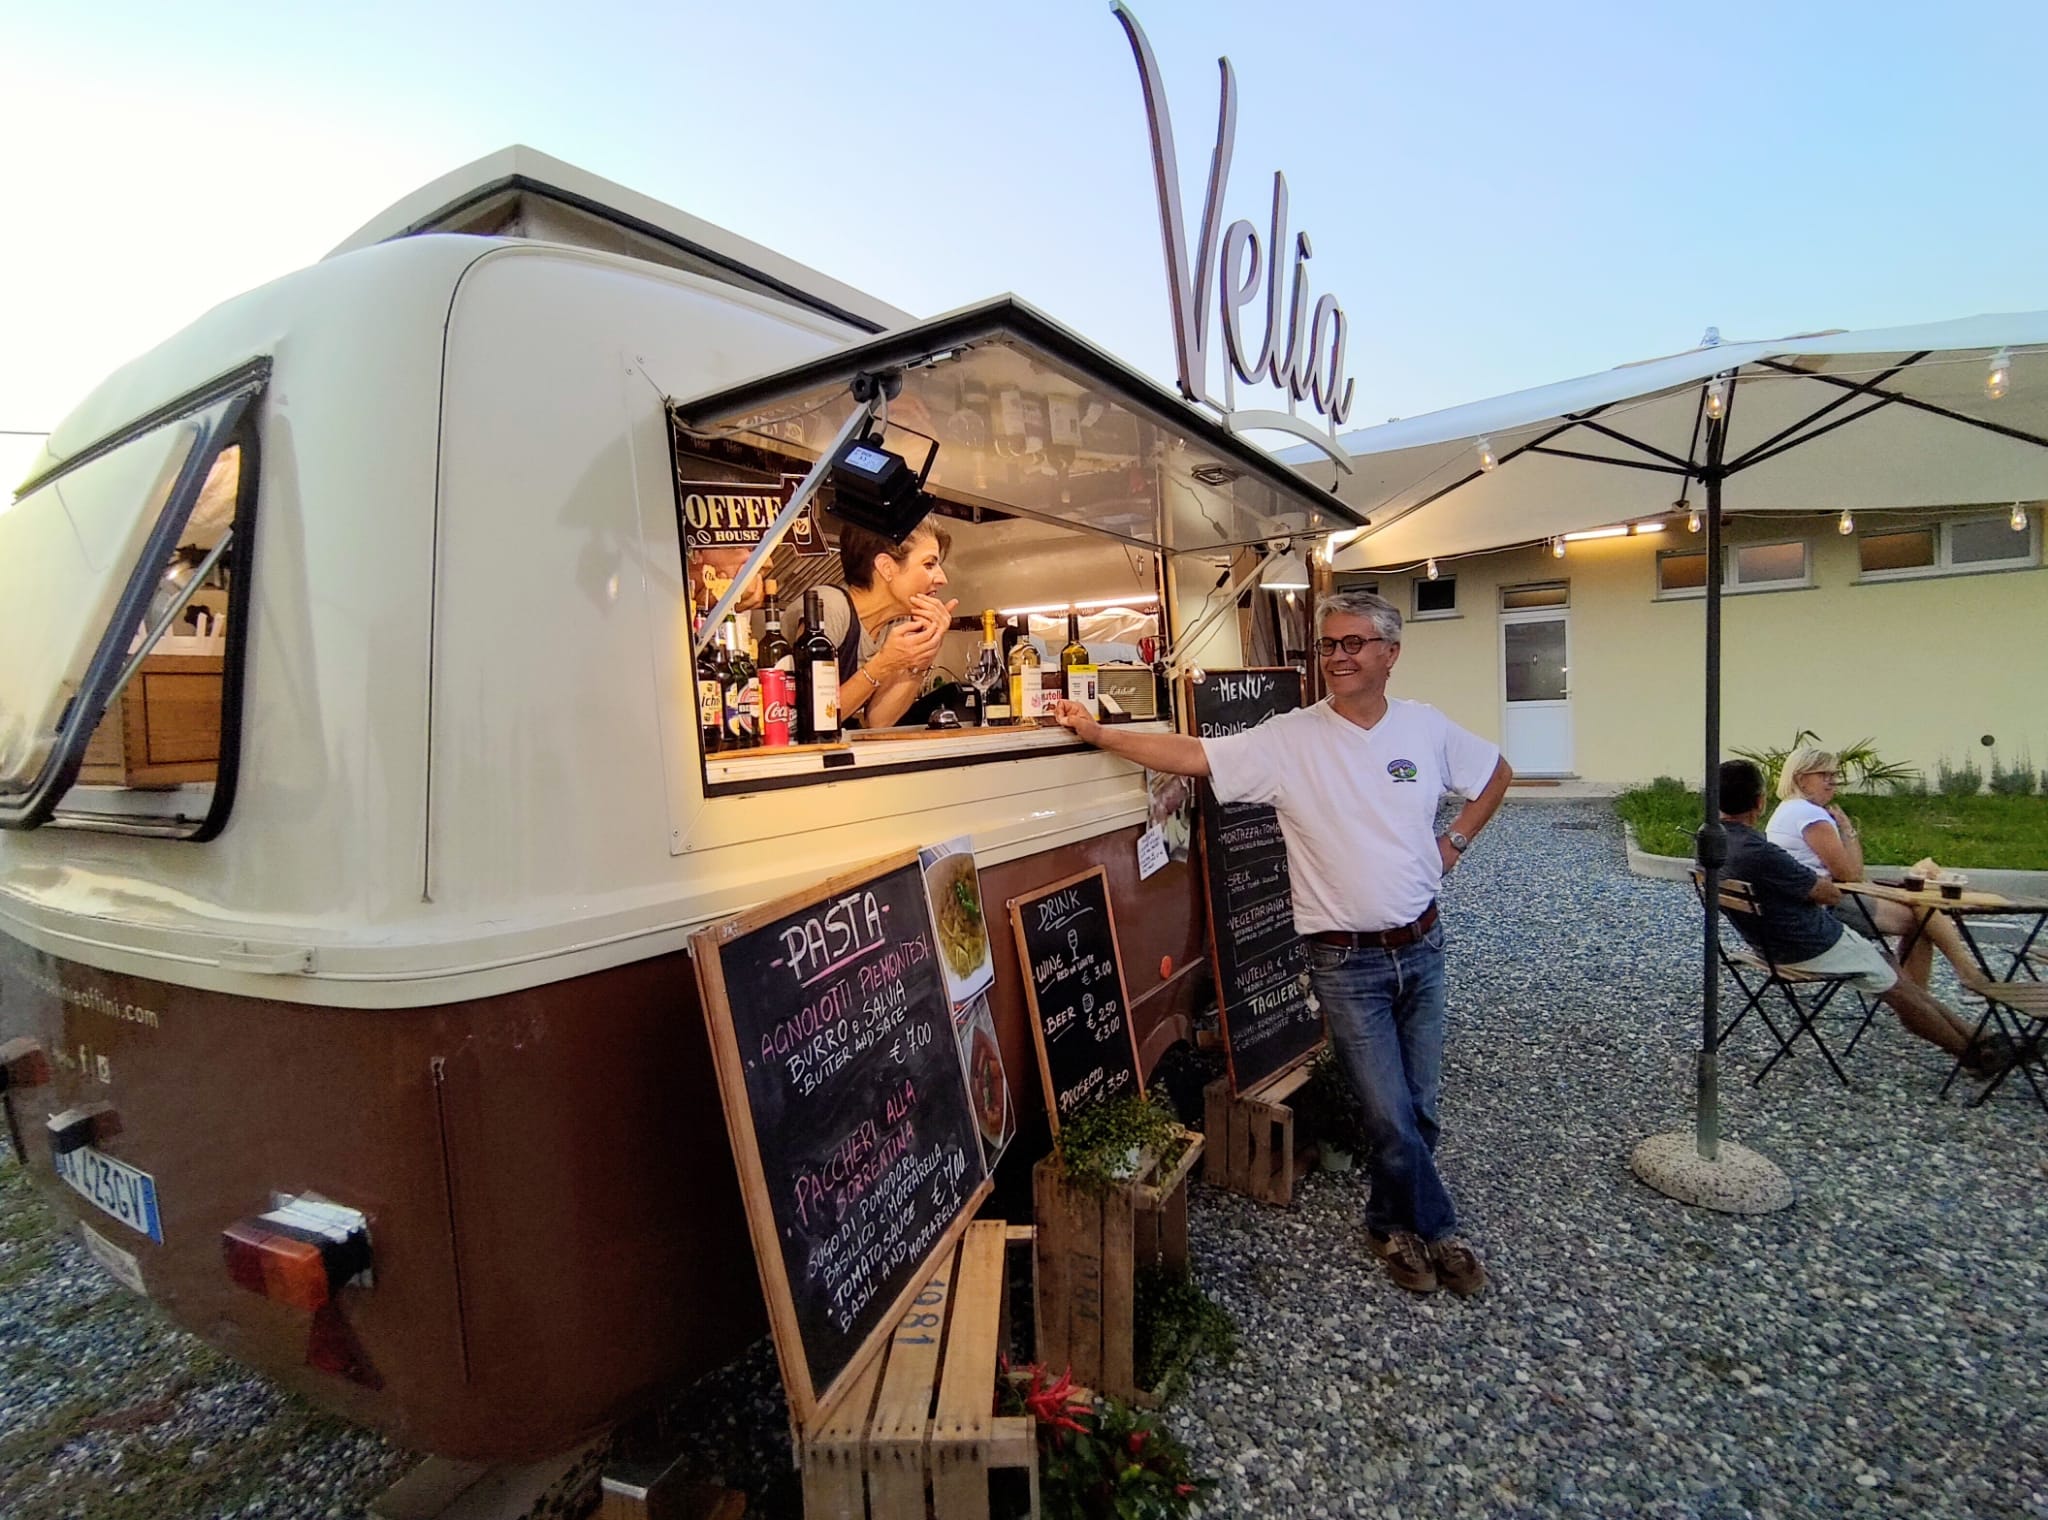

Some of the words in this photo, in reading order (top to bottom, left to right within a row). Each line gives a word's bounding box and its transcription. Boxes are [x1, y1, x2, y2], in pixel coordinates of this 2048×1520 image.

[1109, 0, 1354, 424] Velia
[684, 493, 783, 529] OFFEE
[715, 530, 761, 541] HOUSE
[1037, 889, 1081, 931] DRINK
[761, 977, 853, 1064] AGNOLOTTI
[857, 933, 930, 994] PIEMONTESI
[1036, 953, 1064, 983] WINE
[1236, 960, 1274, 989] NUTELLA
[786, 1019, 849, 1084] BURRO
[863, 979, 907, 1029] SALVIA
[1046, 1006, 1077, 1035] BEER
[803, 1048, 853, 1096] BUTTER
[1060, 1066, 1104, 1113] PROSECCO
[794, 1118, 878, 1227] PACCHERI
[886, 1079, 917, 1124] ALLA
[836, 1119, 916, 1223] SORRENTINA
[808, 1233, 840, 1279] SUGO
[841, 1216, 857, 1241] DI
[823, 1221, 876, 1289] BASILICO
[887, 1143, 943, 1217] MOZZARELLA
[833, 1243, 883, 1307] TOMATO
[883, 1199, 916, 1253] SAUCE
[839, 1276, 879, 1334] BASIL
[881, 1240, 907, 1281] AND
